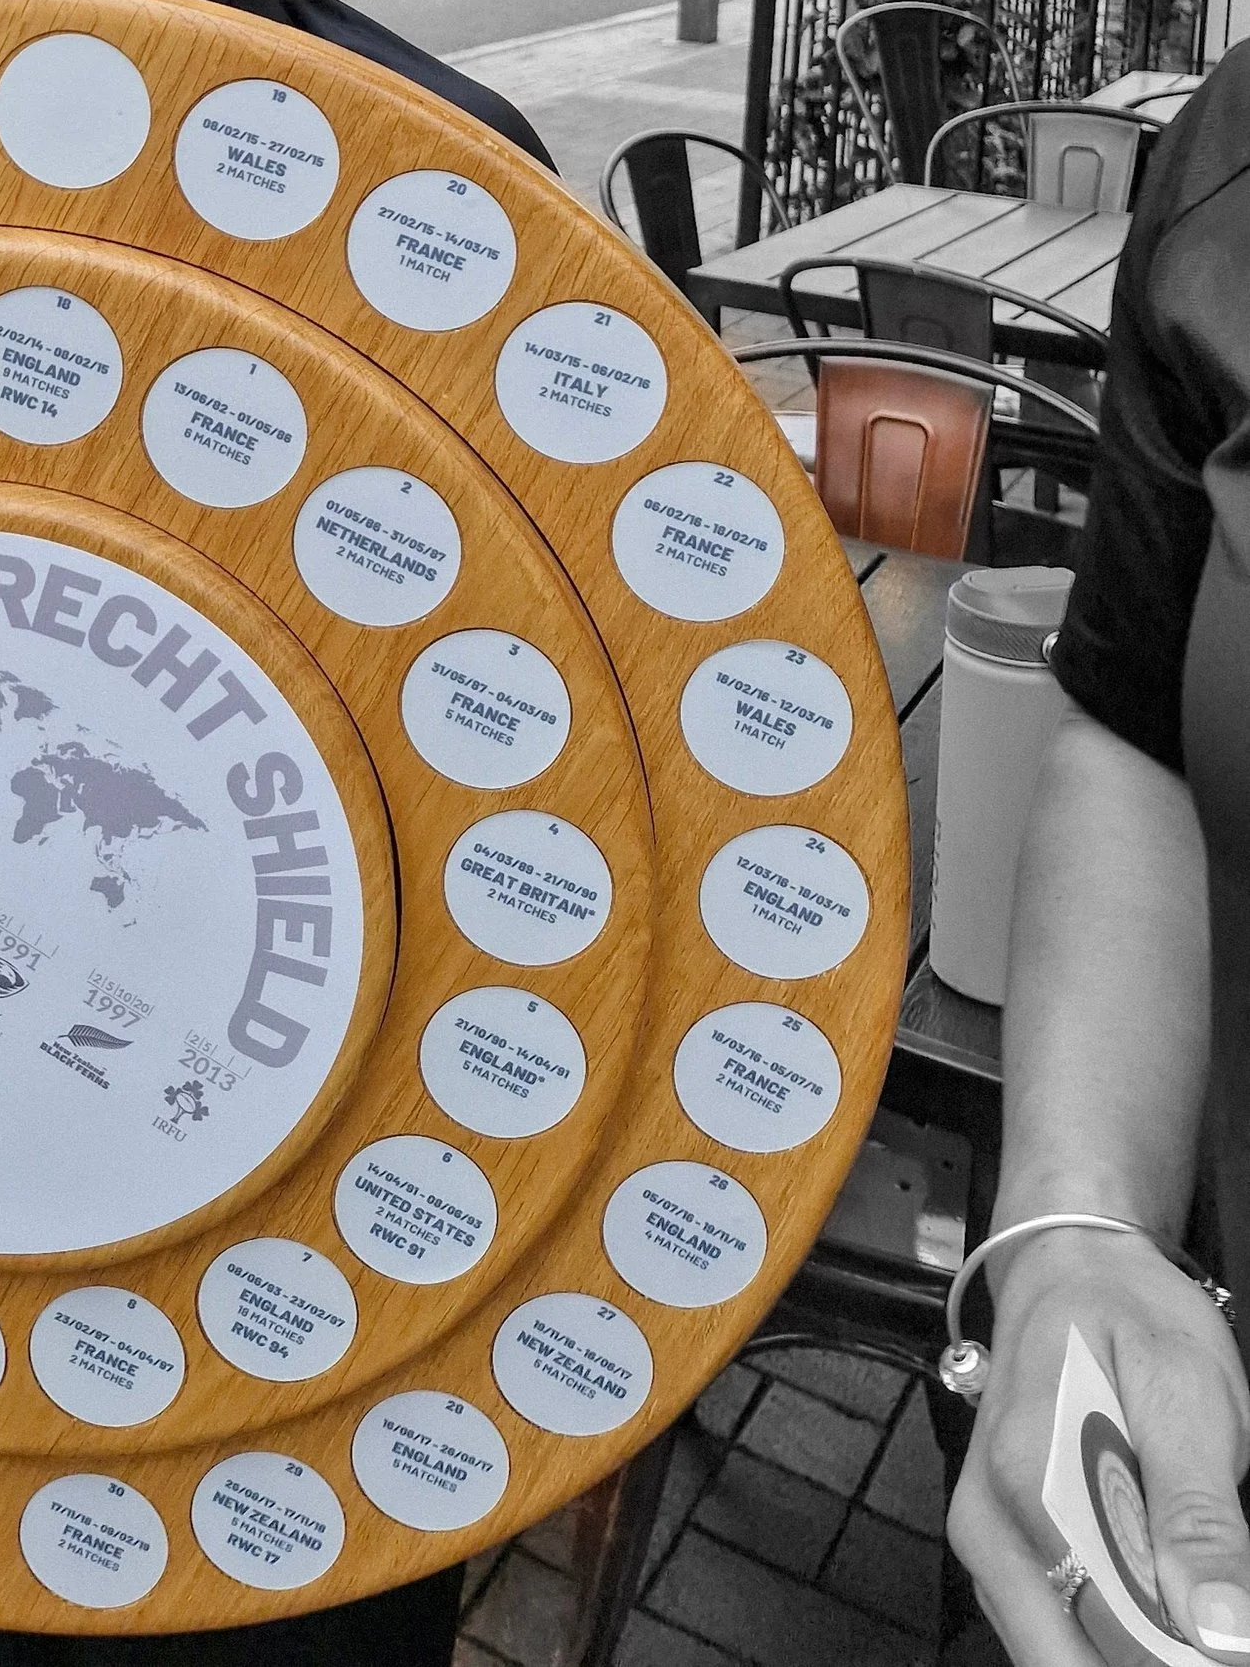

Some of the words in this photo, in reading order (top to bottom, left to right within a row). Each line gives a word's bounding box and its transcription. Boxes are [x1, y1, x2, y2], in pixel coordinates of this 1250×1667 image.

[271, 88, 288, 104] 19
[216, 162, 226, 174] 2
[226, 165, 286, 194] MATCHES
[228, 145, 288, 178] WALES
[446, 179, 468, 196] 20
[377, 206, 436, 236] 27/02/15
[444, 231, 501, 261] 14/03/15
[395, 233, 467, 272] FRANCE
[56, 295, 72, 311] 18
[593, 311, 612, 327] 21
[1, 347, 82, 387] ENGLAND
[524, 341, 582, 368] 14/03/15
[590, 362, 652, 390] 06/02/16
[553, 370, 609, 399] ITALY
[0, 385, 39, 410] RWC
[40, 400, 58, 418] 14
[190, 410, 260, 452] FRANCE
[713, 471, 735, 488] 22
[315, 515, 438, 582] NETHERLANDS
[654, 542, 665, 554] 2
[665, 546, 728, 577] MATCHES
[661, 524, 735, 563] FRANCE
[784, 649, 806, 666] 23
[450, 691, 521, 732] FRANCE
[736, 699, 797, 737] WALES
[804, 837, 826, 854] 24
[460, 857, 519, 890] GREAT
[225, 751, 333, 1069] SHIELD
[486, 888, 497, 899] 2
[496, 891, 558, 924] MATCHES
[742, 880, 824, 927] ENGLAND
[83, 989, 140, 1029] 1997
[781, 1015, 803, 1032] 25
[39, 1042, 76, 1070] BLACK
[75, 1063, 110, 1090] FERNS
[178, 1048, 237, 1092] 2013
[722, 1057, 791, 1101] FRANCE
[151, 1115, 188, 1143] IRFU
[708, 1174, 729, 1191] 26
[354, 1175, 412, 1214] UNITED
[412, 1207, 476, 1248] STATES
[369, 1222, 408, 1250] RWC
[406, 1242, 426, 1260] 91
[645, 1211, 722, 1260] ENGLAND
[238, 1288, 315, 1334] ENGLAND
[596, 1306, 617, 1321] 27
[74, 1338, 140, 1378] FRANCE
[230, 1320, 269, 1347] RWC
[268, 1340, 289, 1359] 94
[516, 1330, 556, 1358] NEW
[552, 1351, 628, 1400] ZEALAND
[391, 1440, 468, 1482] ENGLAND
[107, 1482, 126, 1498] 30
[212, 1490, 250, 1516] NEW
[248, 1508, 323, 1552] ZEALAND
[62, 1524, 125, 1560] FRANCE
[226, 1532, 263, 1558] RWC
[264, 1550, 281, 1565] 17
